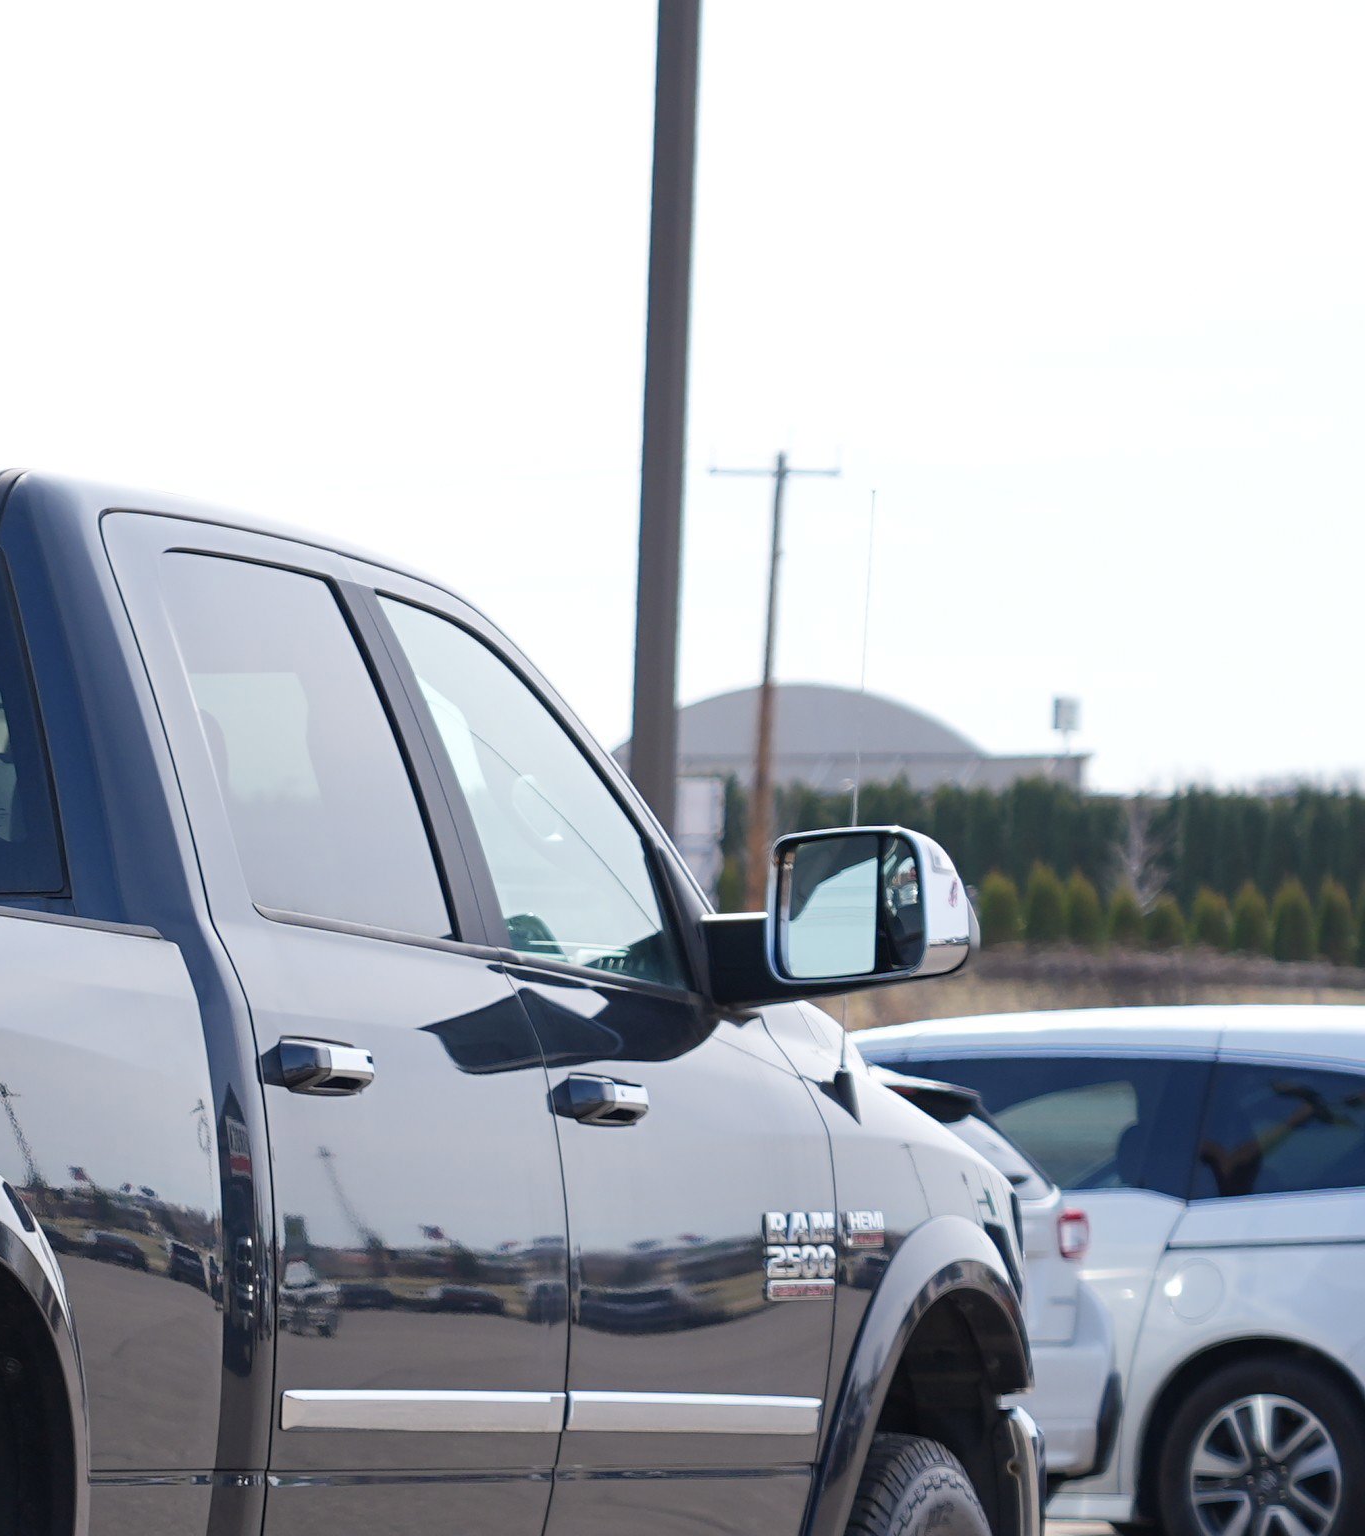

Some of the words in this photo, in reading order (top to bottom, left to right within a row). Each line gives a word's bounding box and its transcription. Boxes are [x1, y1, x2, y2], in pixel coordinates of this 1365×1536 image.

[762, 1211, 836, 1244] RAM
[847, 1210, 885, 1231] HEMI
[766, 1244, 837, 1279] 2500
